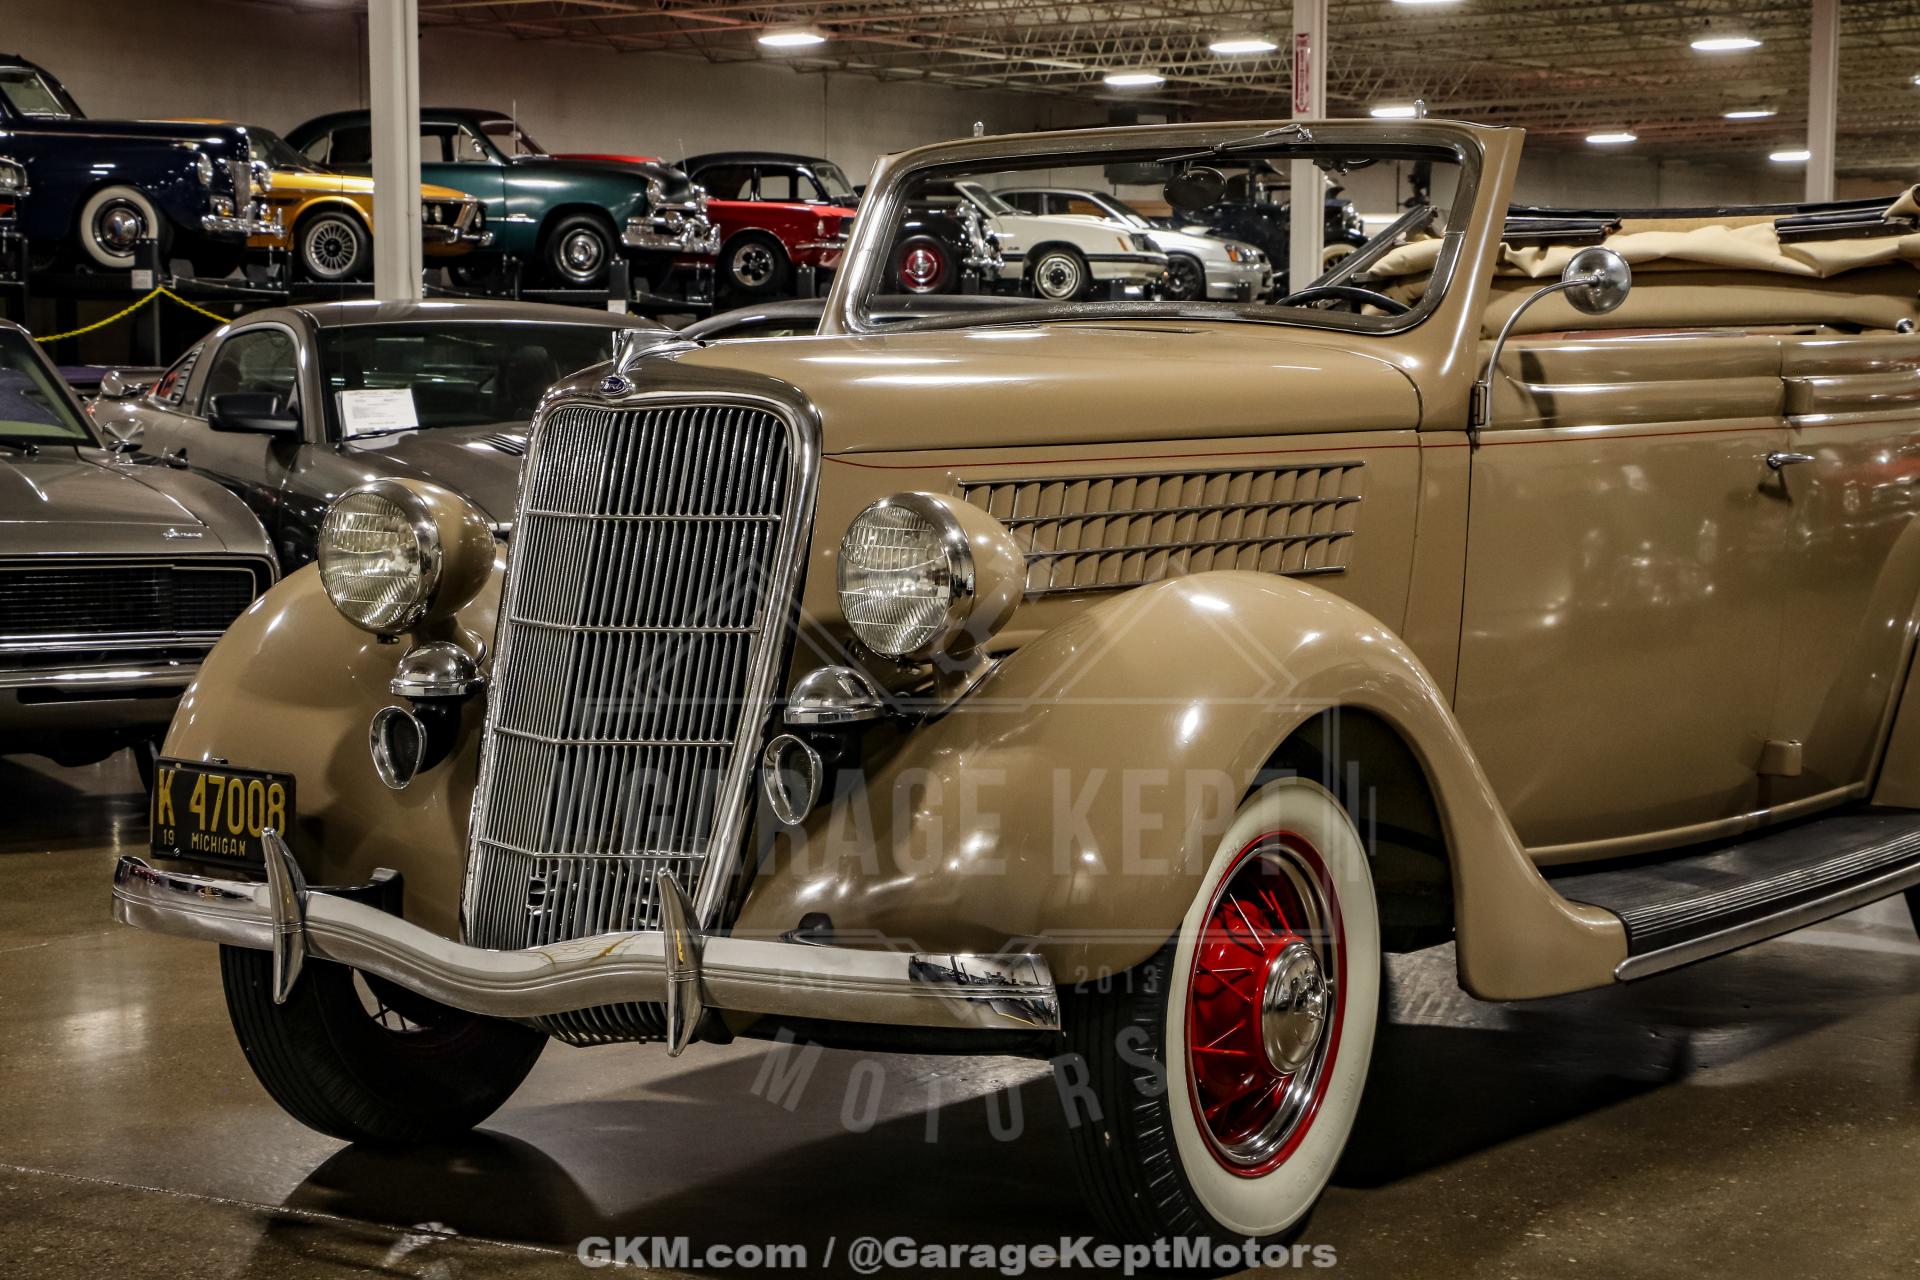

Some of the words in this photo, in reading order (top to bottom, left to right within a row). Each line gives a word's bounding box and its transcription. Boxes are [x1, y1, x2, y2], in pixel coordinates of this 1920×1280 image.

[158, 768, 176, 826] K
[189, 773, 286, 838] 47008
[163, 828, 175, 846] 19
[191, 832, 246, 857] MICHIGAN
